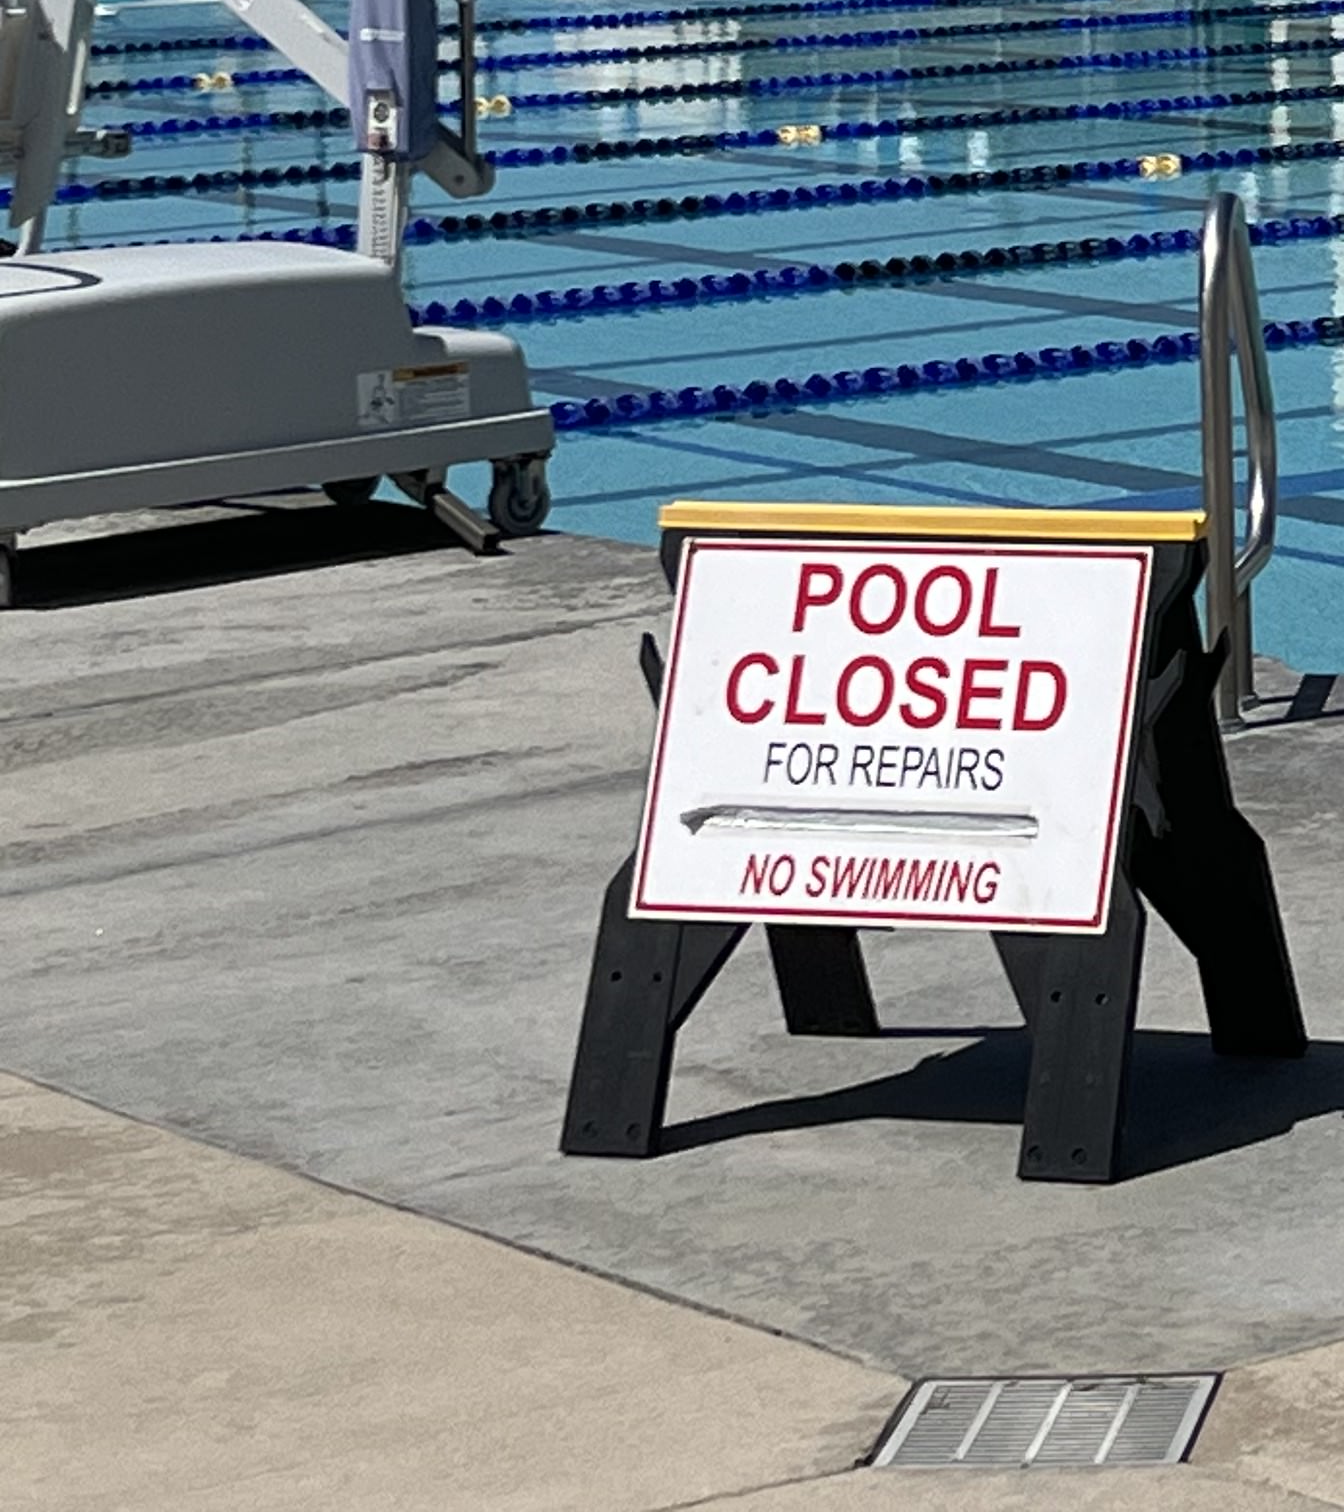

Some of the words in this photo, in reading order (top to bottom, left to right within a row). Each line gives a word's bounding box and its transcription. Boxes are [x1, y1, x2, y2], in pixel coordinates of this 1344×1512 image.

[792, 563, 1020, 637] POOL
[726, 652, 1067, 731] CLOSED
[763, 742, 839, 785] FOR
[849, 745, 1005, 791] REPAIRS
[739, 854, 796, 897] NO
[805, 855, 1002, 904] SWIMMING
